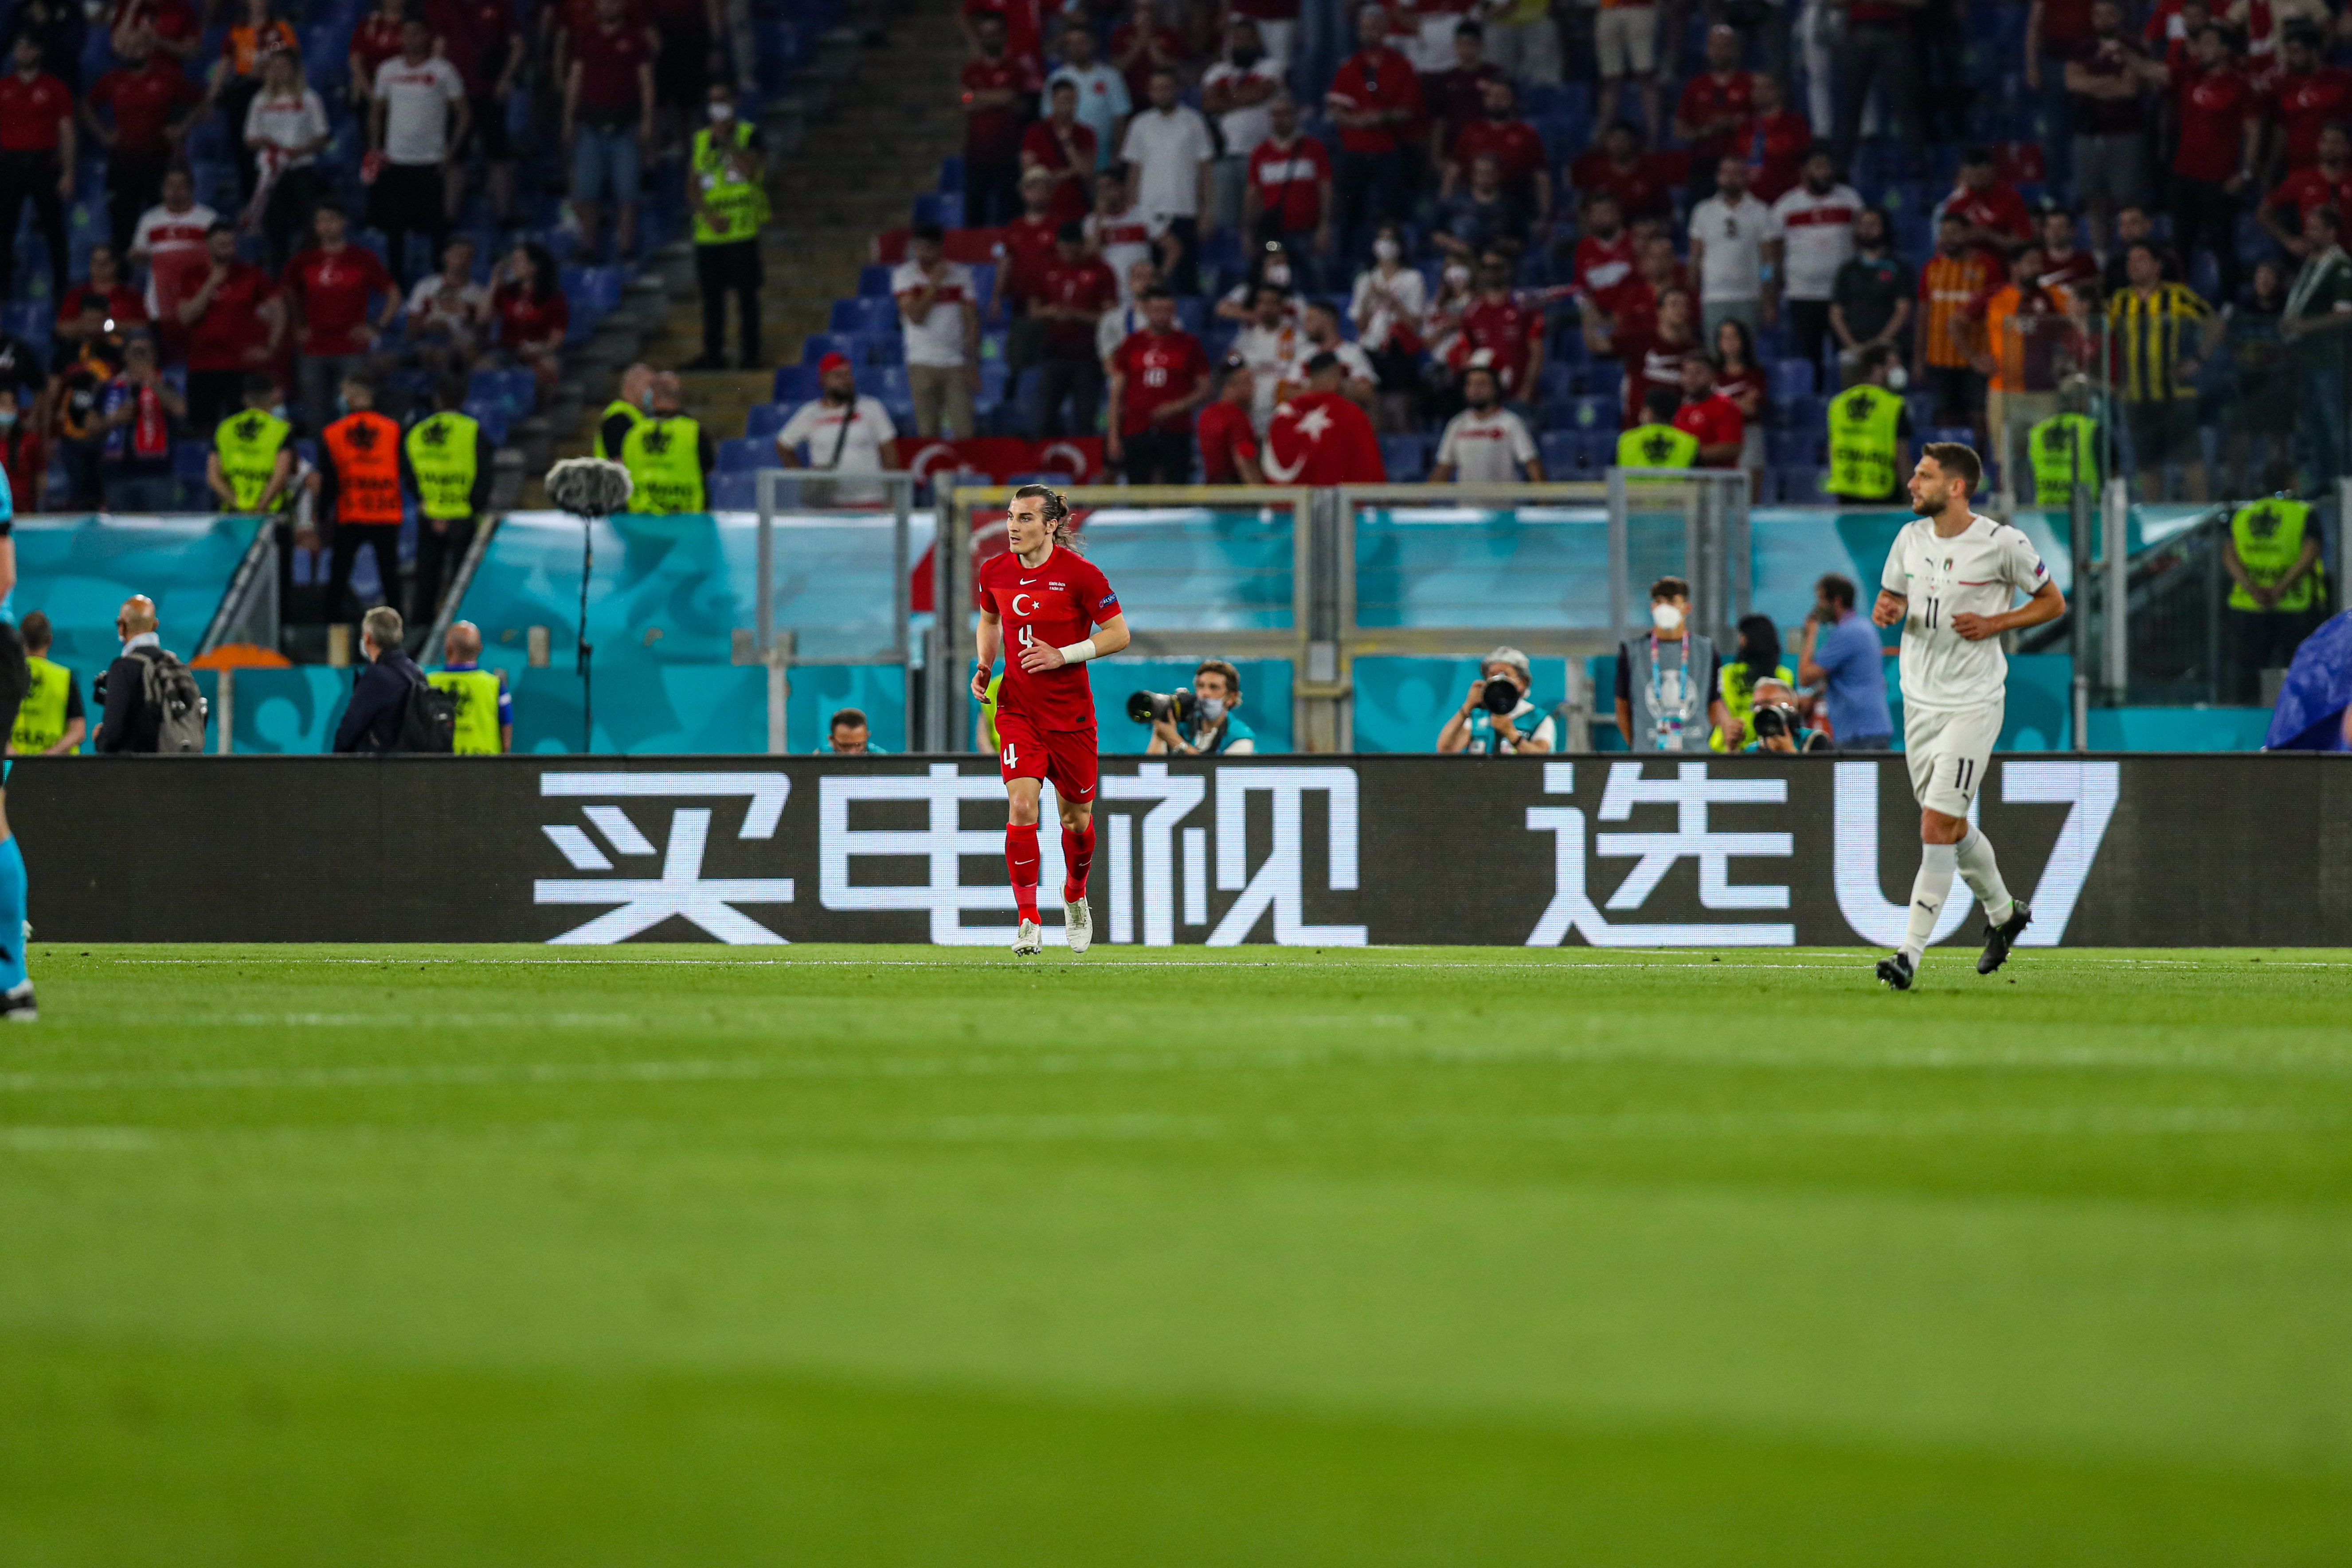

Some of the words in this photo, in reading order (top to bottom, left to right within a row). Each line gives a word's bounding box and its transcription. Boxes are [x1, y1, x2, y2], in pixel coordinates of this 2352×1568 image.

[1925, 596, 1938, 629] 11
[1018, 624, 1033, 649] 4
[1003, 743, 1019, 769] 4
[1954, 757, 1974, 790] 11
[533, 762, 1369, 946] 买电视
